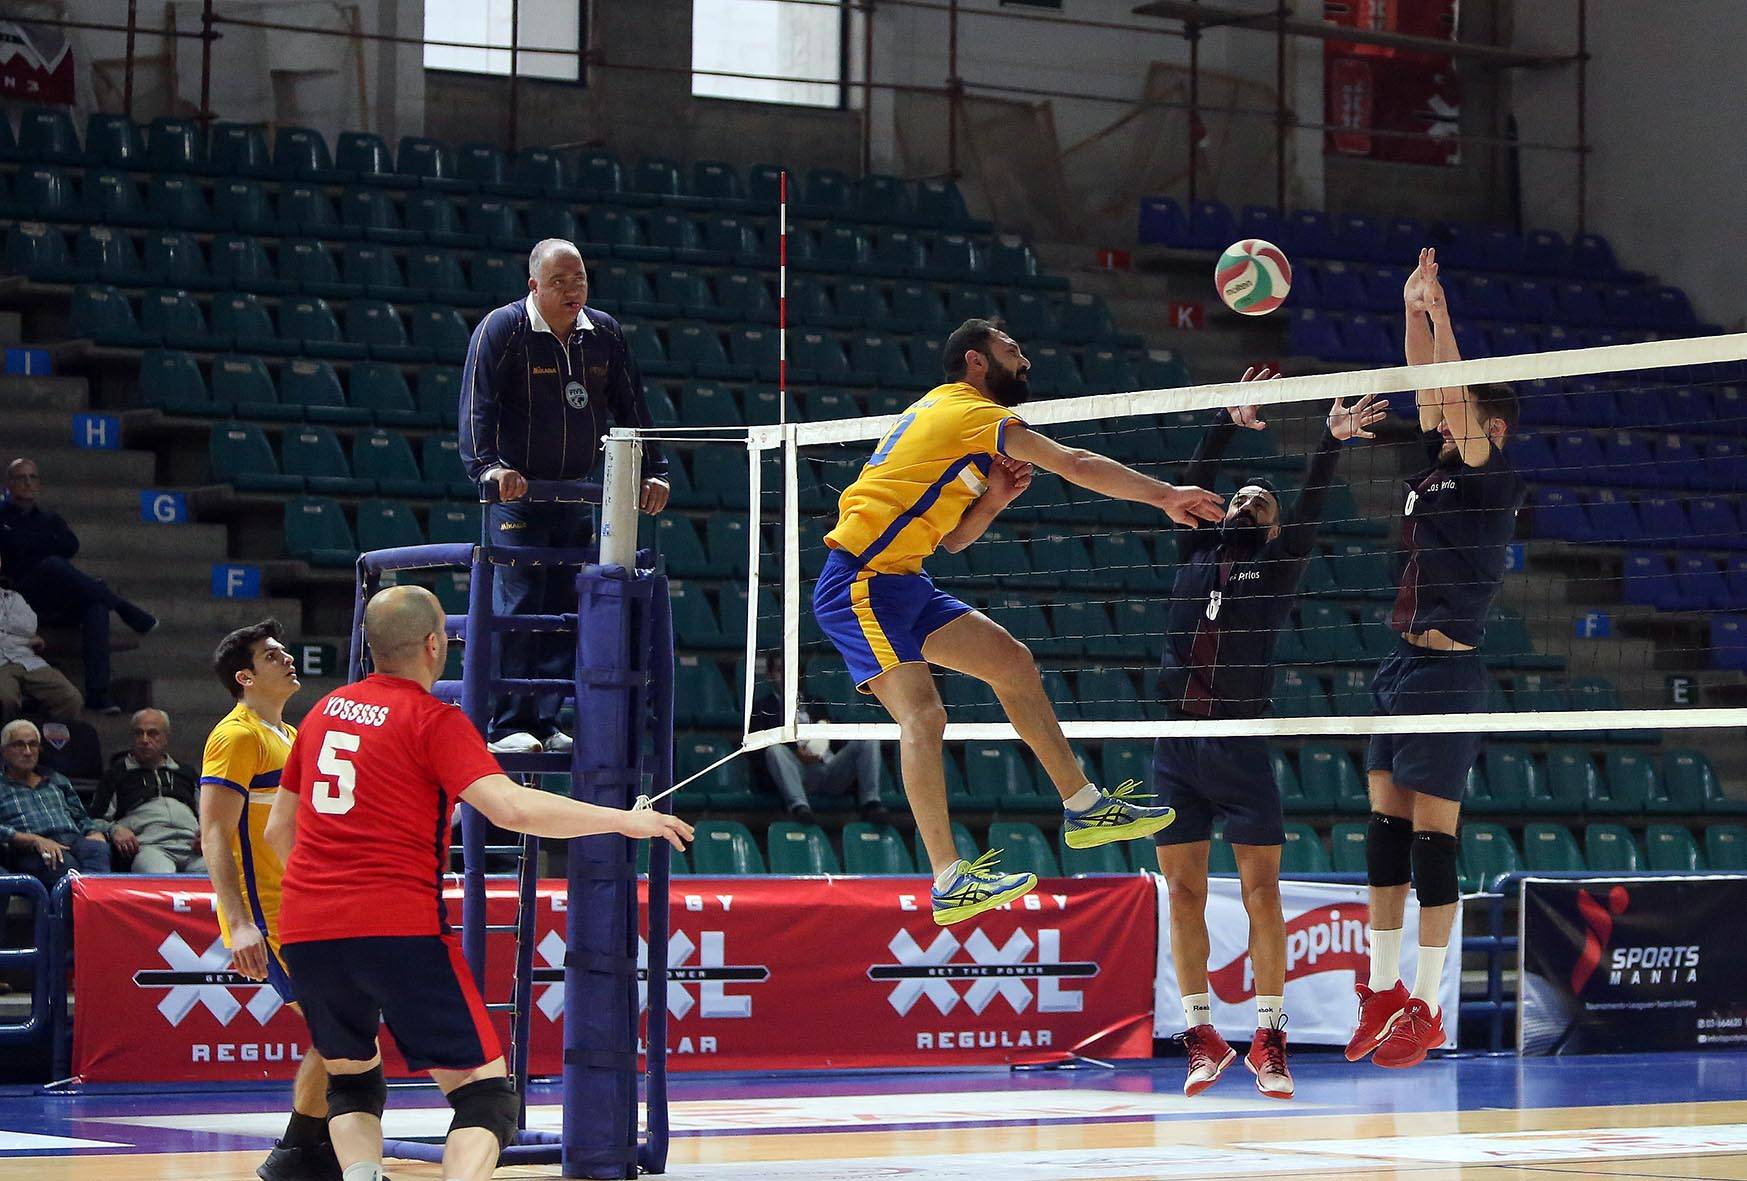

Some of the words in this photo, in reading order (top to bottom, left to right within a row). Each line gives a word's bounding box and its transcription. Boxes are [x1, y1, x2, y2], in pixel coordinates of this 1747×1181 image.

[1177, 306, 1193, 328] K
[86, 419, 106, 446] H
[153, 494, 176, 522] G
[226, 568, 245, 597] F
[1585, 613, 1600, 638] F
[303, 646, 322, 675] E
[1673, 678, 1689, 703] E
[311, 730, 361, 815] 5
[899, 894, 1067, 911] EGY
[1612, 946, 1700, 969] SPORTS
[887, 927, 1083, 1018] XXL
[928, 968, 954, 976] GET
[963, 968, 988, 976] THE
[996, 967, 1043, 976] POWER
[1609, 969, 1697, 984] MANIA
[916, 1030, 1053, 1049] REGULAR
[191, 1043, 305, 1062] REGUL
